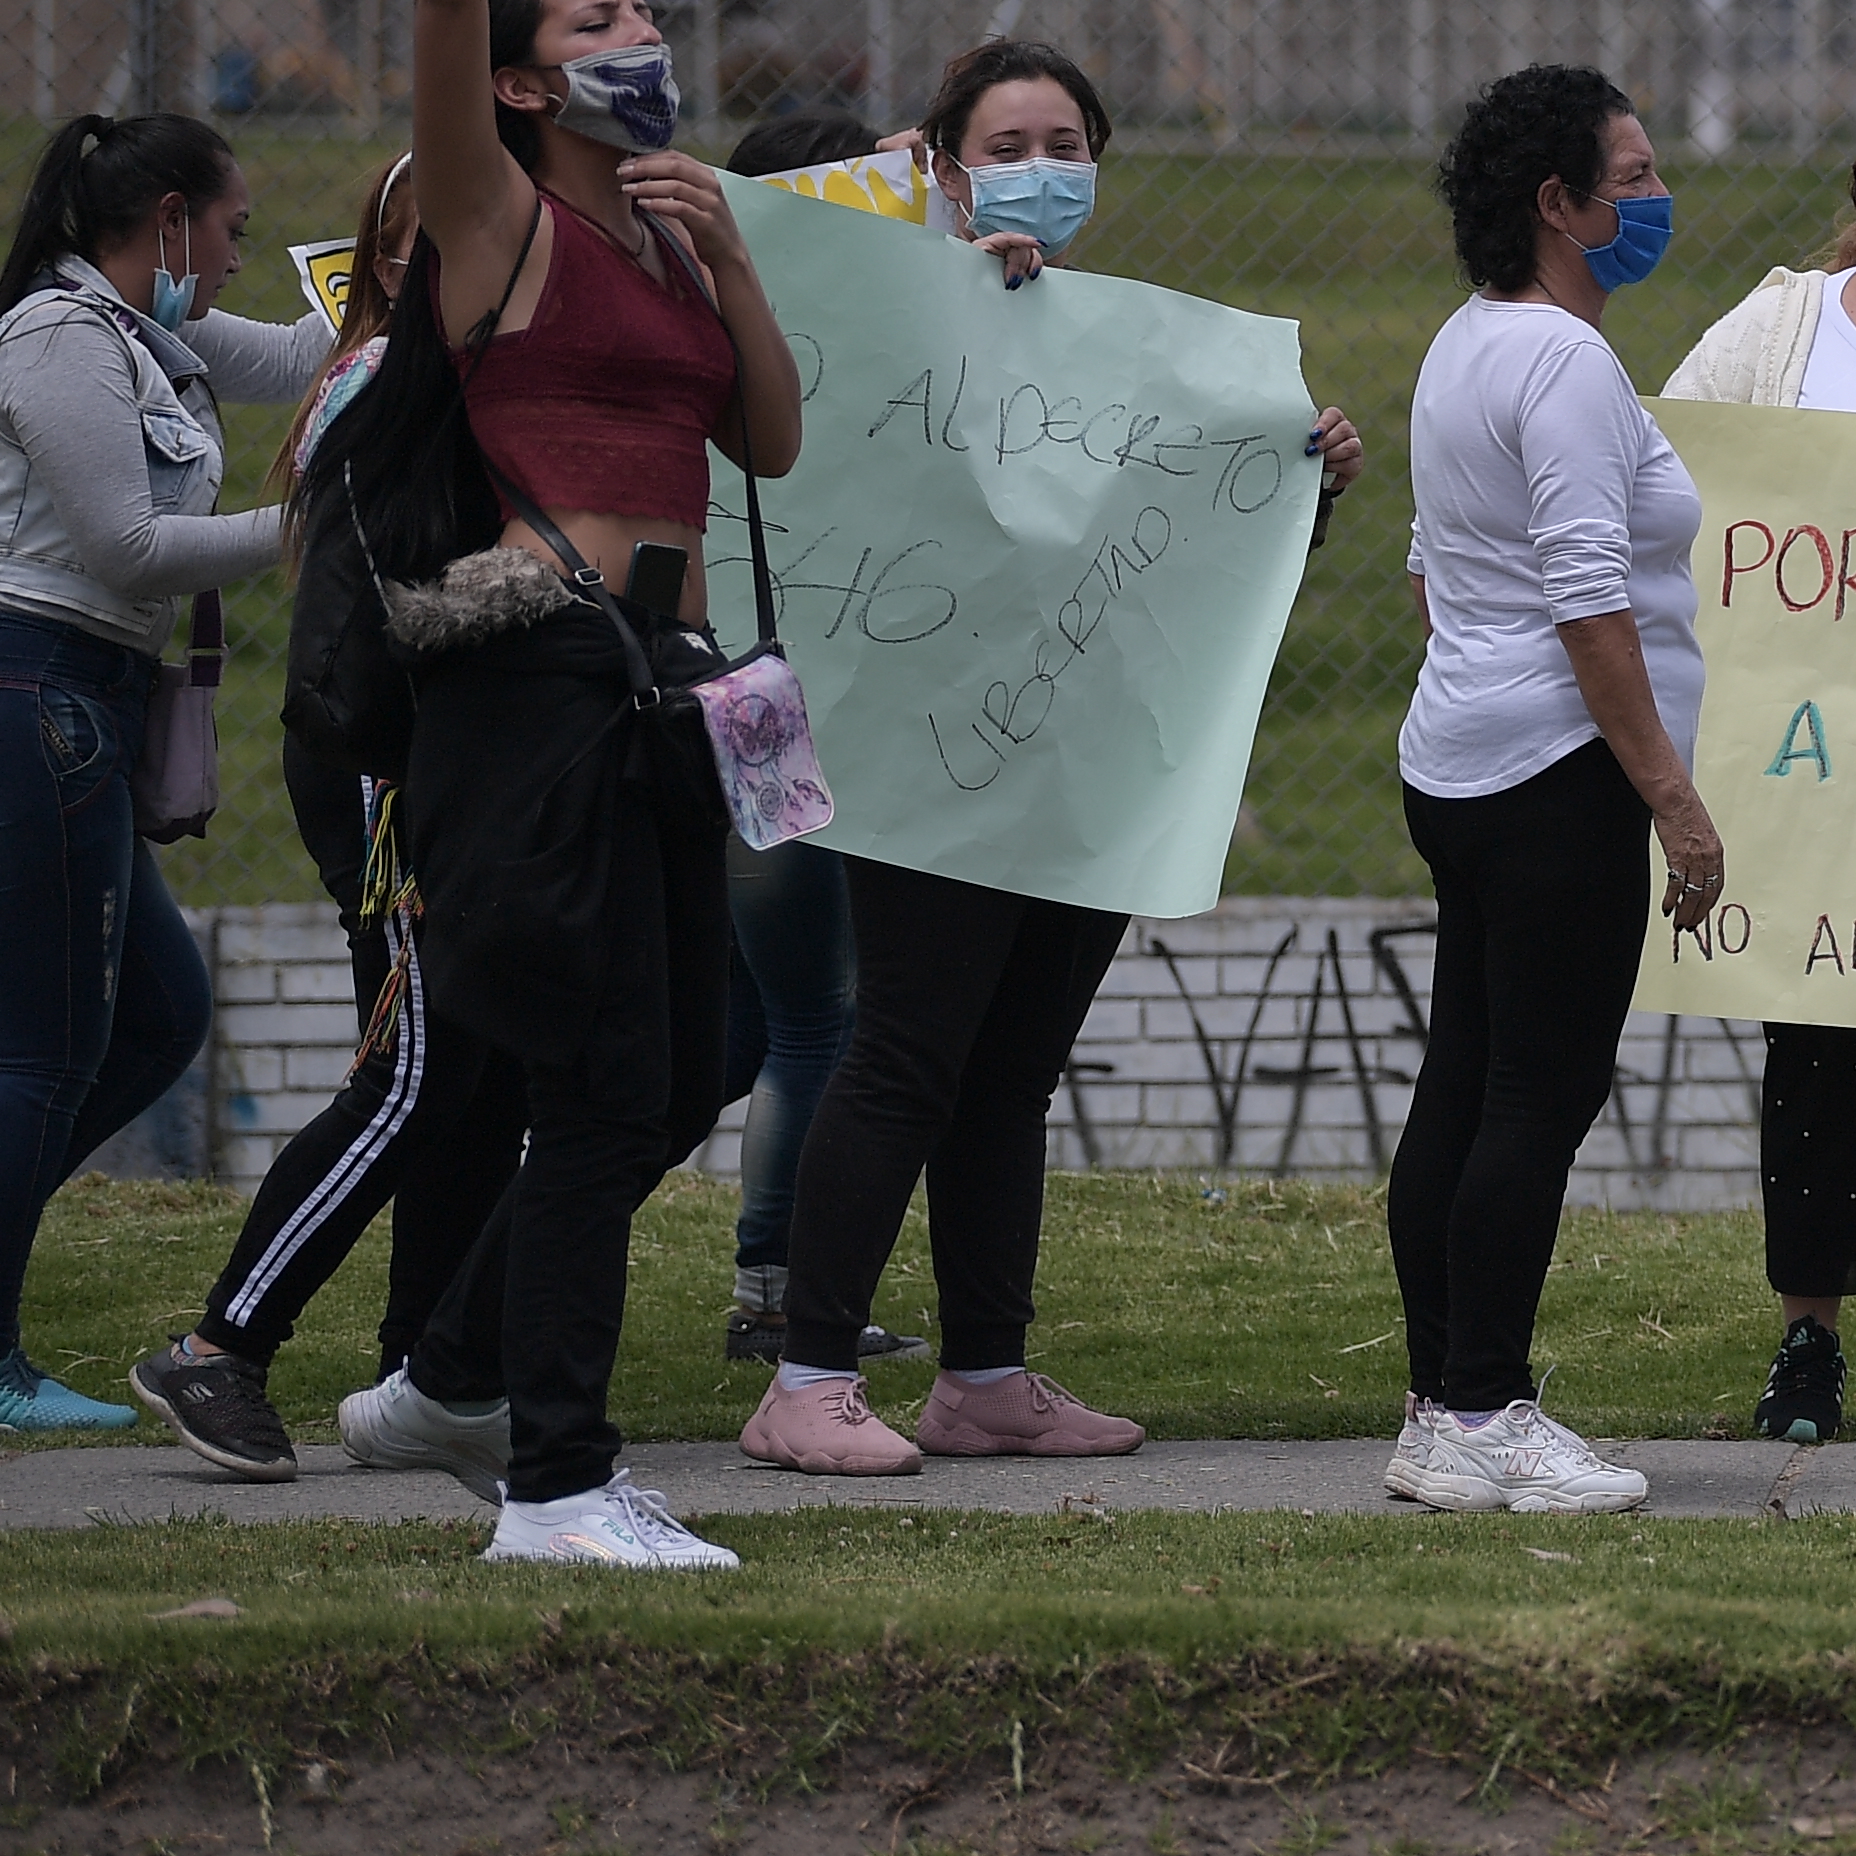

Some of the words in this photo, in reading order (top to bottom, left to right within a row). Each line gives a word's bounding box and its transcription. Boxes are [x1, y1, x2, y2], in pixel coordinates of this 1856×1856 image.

[866, 354, 970, 453] AL
[994, 382, 1283, 514] DECRETO
[1763, 699, 1832, 782] A
[1672, 903, 1751, 964] NO
[600, 1517, 635, 1546] FILA
